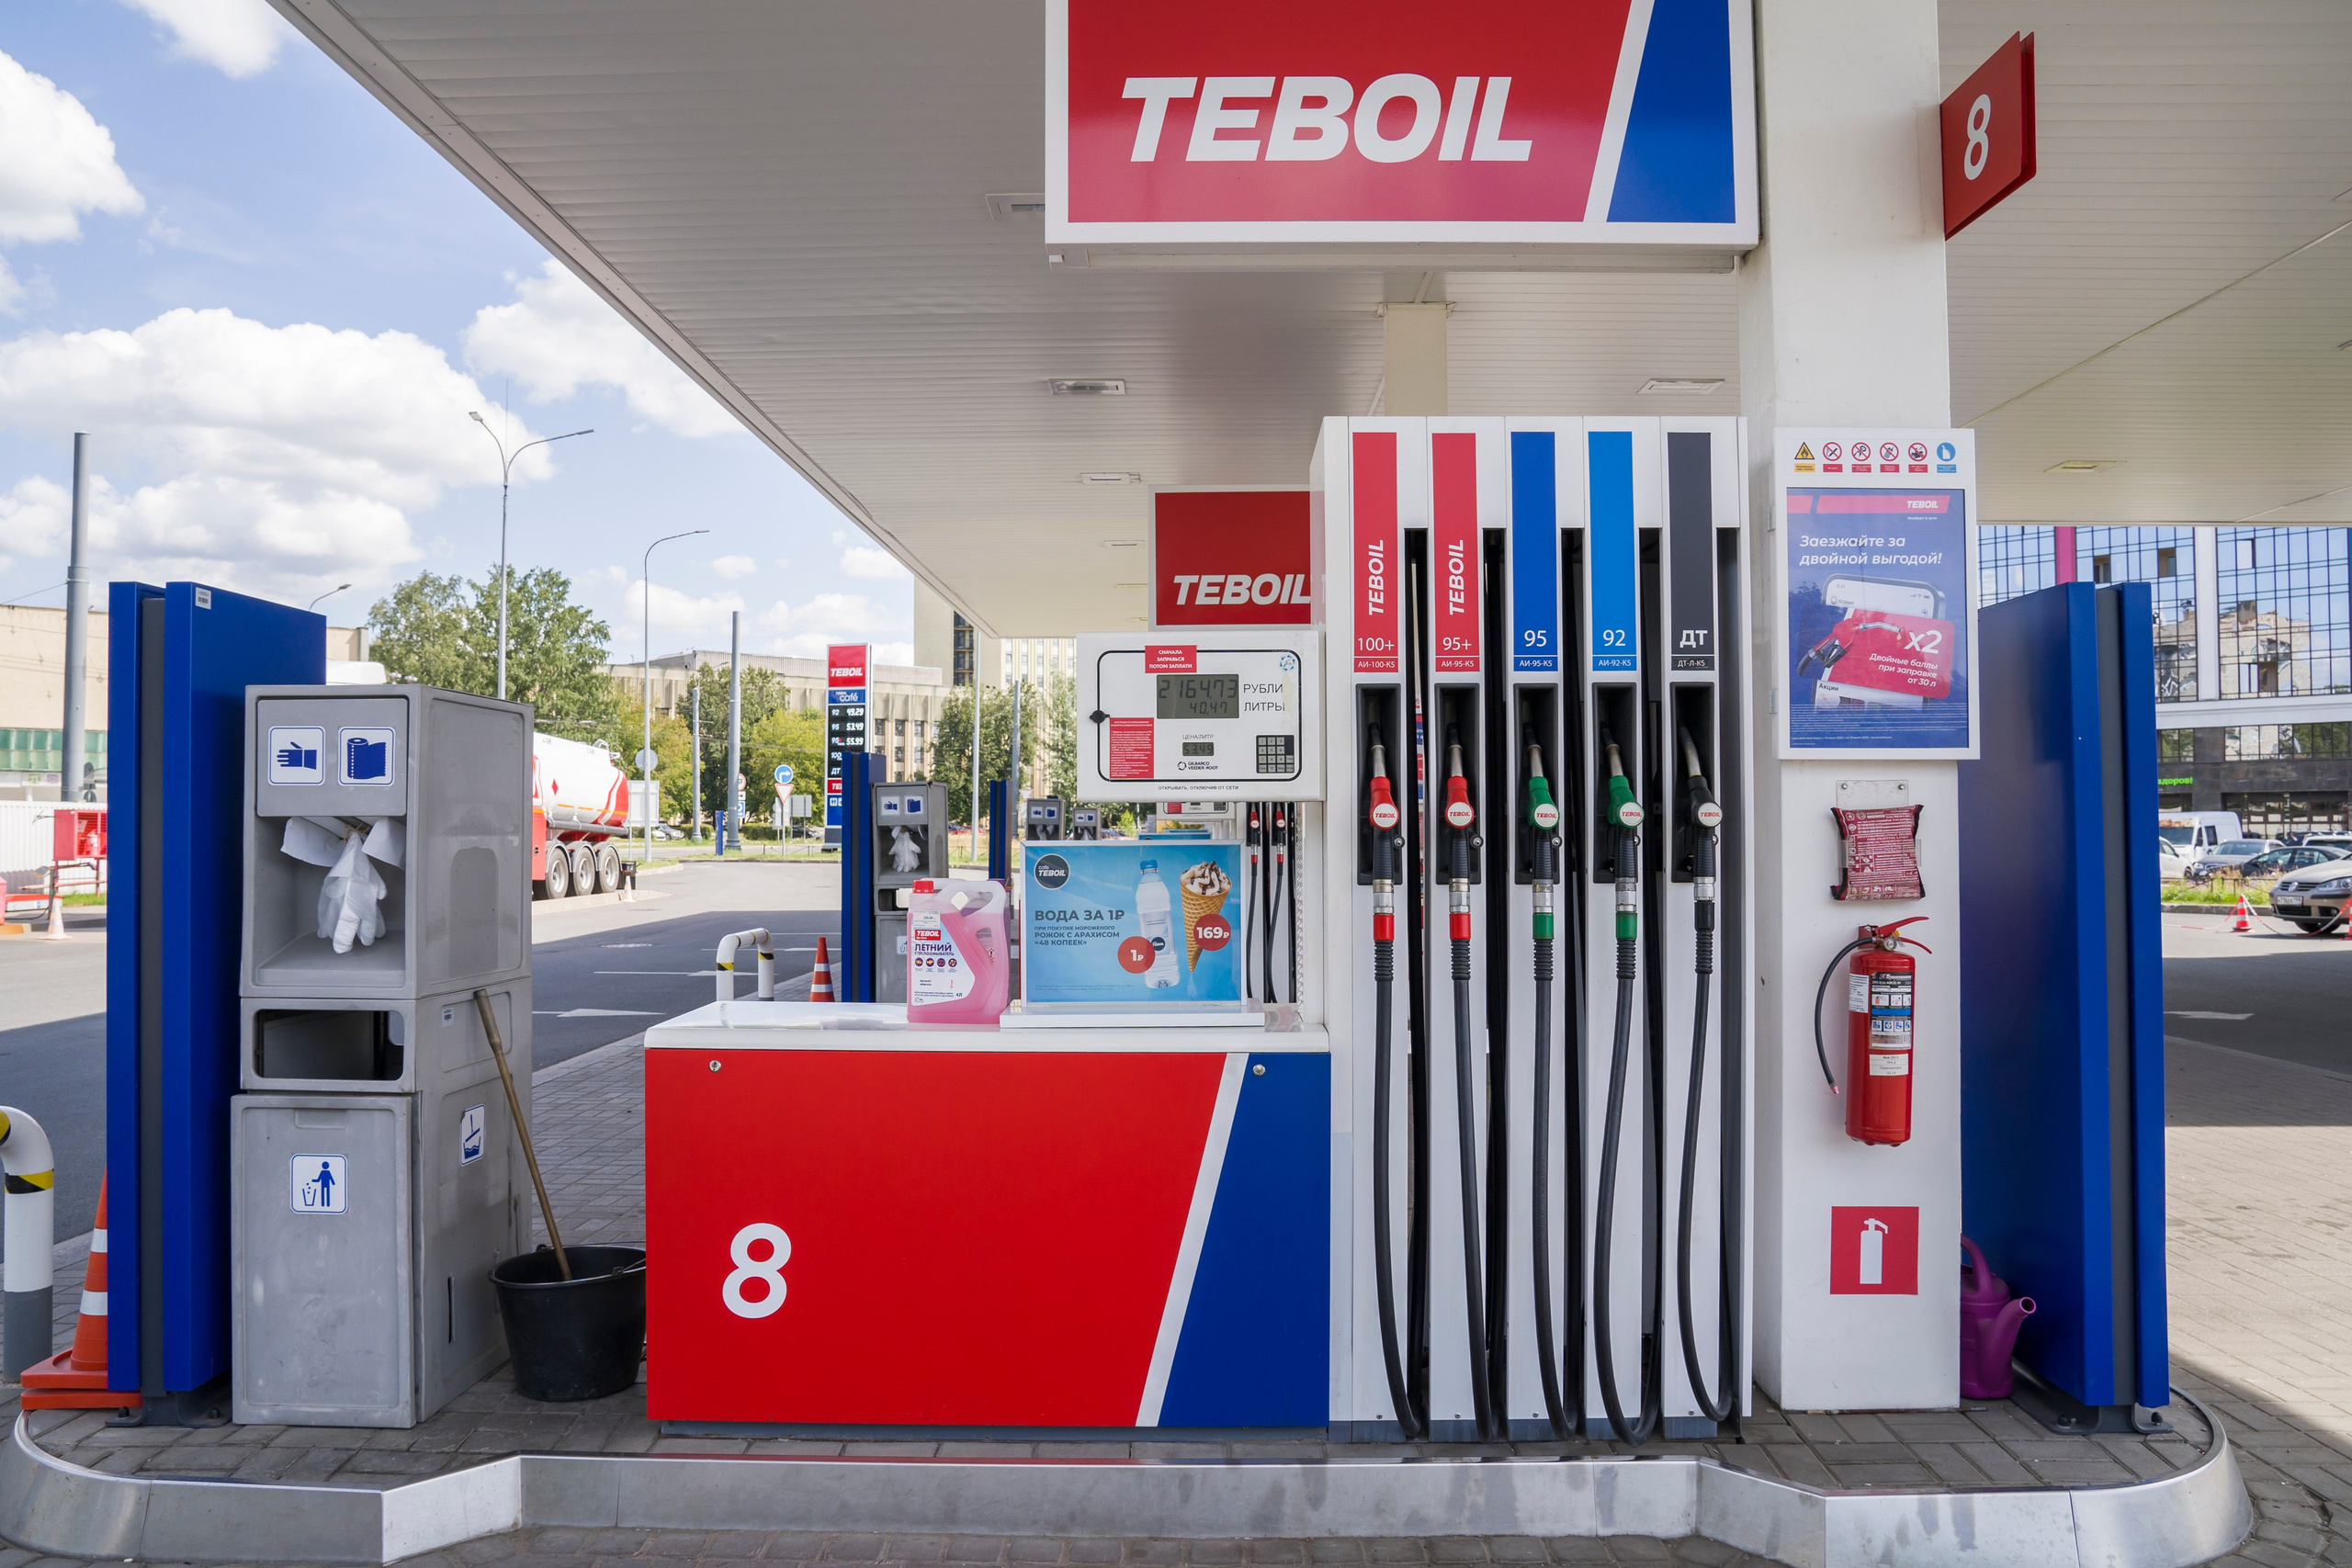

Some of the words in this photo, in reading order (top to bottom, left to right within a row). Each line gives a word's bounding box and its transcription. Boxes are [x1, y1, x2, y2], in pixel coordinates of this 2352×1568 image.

[1121, 73, 1532, 164] TEBOIL
[1962, 93, 1993, 181] 8
[1906, 501, 1939, 509] TEBOIL
[1799, 535, 1884, 547] Заезжайте
[1887, 537, 1906, 547] за
[1799, 552, 1868, 566] двойной
[1871, 552, 1942, 566] выгодой!
[1368, 539, 1385, 615] TEBOIL
[1448, 539, 1464, 615] TEBOIL
[1173, 573, 1311, 605] TEBOIL
[1357, 637, 1395, 651] 100+
[1442, 637, 1472, 650] 95+
[1523, 629, 1547, 647] 95
[1602, 629, 1626, 647] 92
[1679, 629, 1708, 649] ДТ
[1357, 660, 1396, 669] АИ-100-К5
[1441, 660, 1475, 668] АИ-95-К5
[1677, 660, 1706, 668] ДТ-Л-К5
[1869, 653, 1909, 666] Двойные
[1910, 658, 1939, 671] баллы
[830, 667, 864, 677] TEBOIL
[1878, 663, 1895, 674] при
[1896, 667, 1938, 679] заправке
[1818, 682, 1839, 692] Акции
[1917, 678, 1929, 686] 30
[1243, 683, 1283, 694] РУБЛИ
[839, 692, 858, 702] café
[831, 708, 841, 716] 92
[1243, 702, 1285, 712] ЛИТРЫ
[831, 723, 840, 731] 95
[1038, 869, 1066, 877] TEBOIL
[1035, 909, 1080, 923] ВОДА
[1083, 909, 1104, 920] ЗА
[914, 942, 952, 952] ЛЕТНИЙ
[722, 1223, 792, 1319] 8
